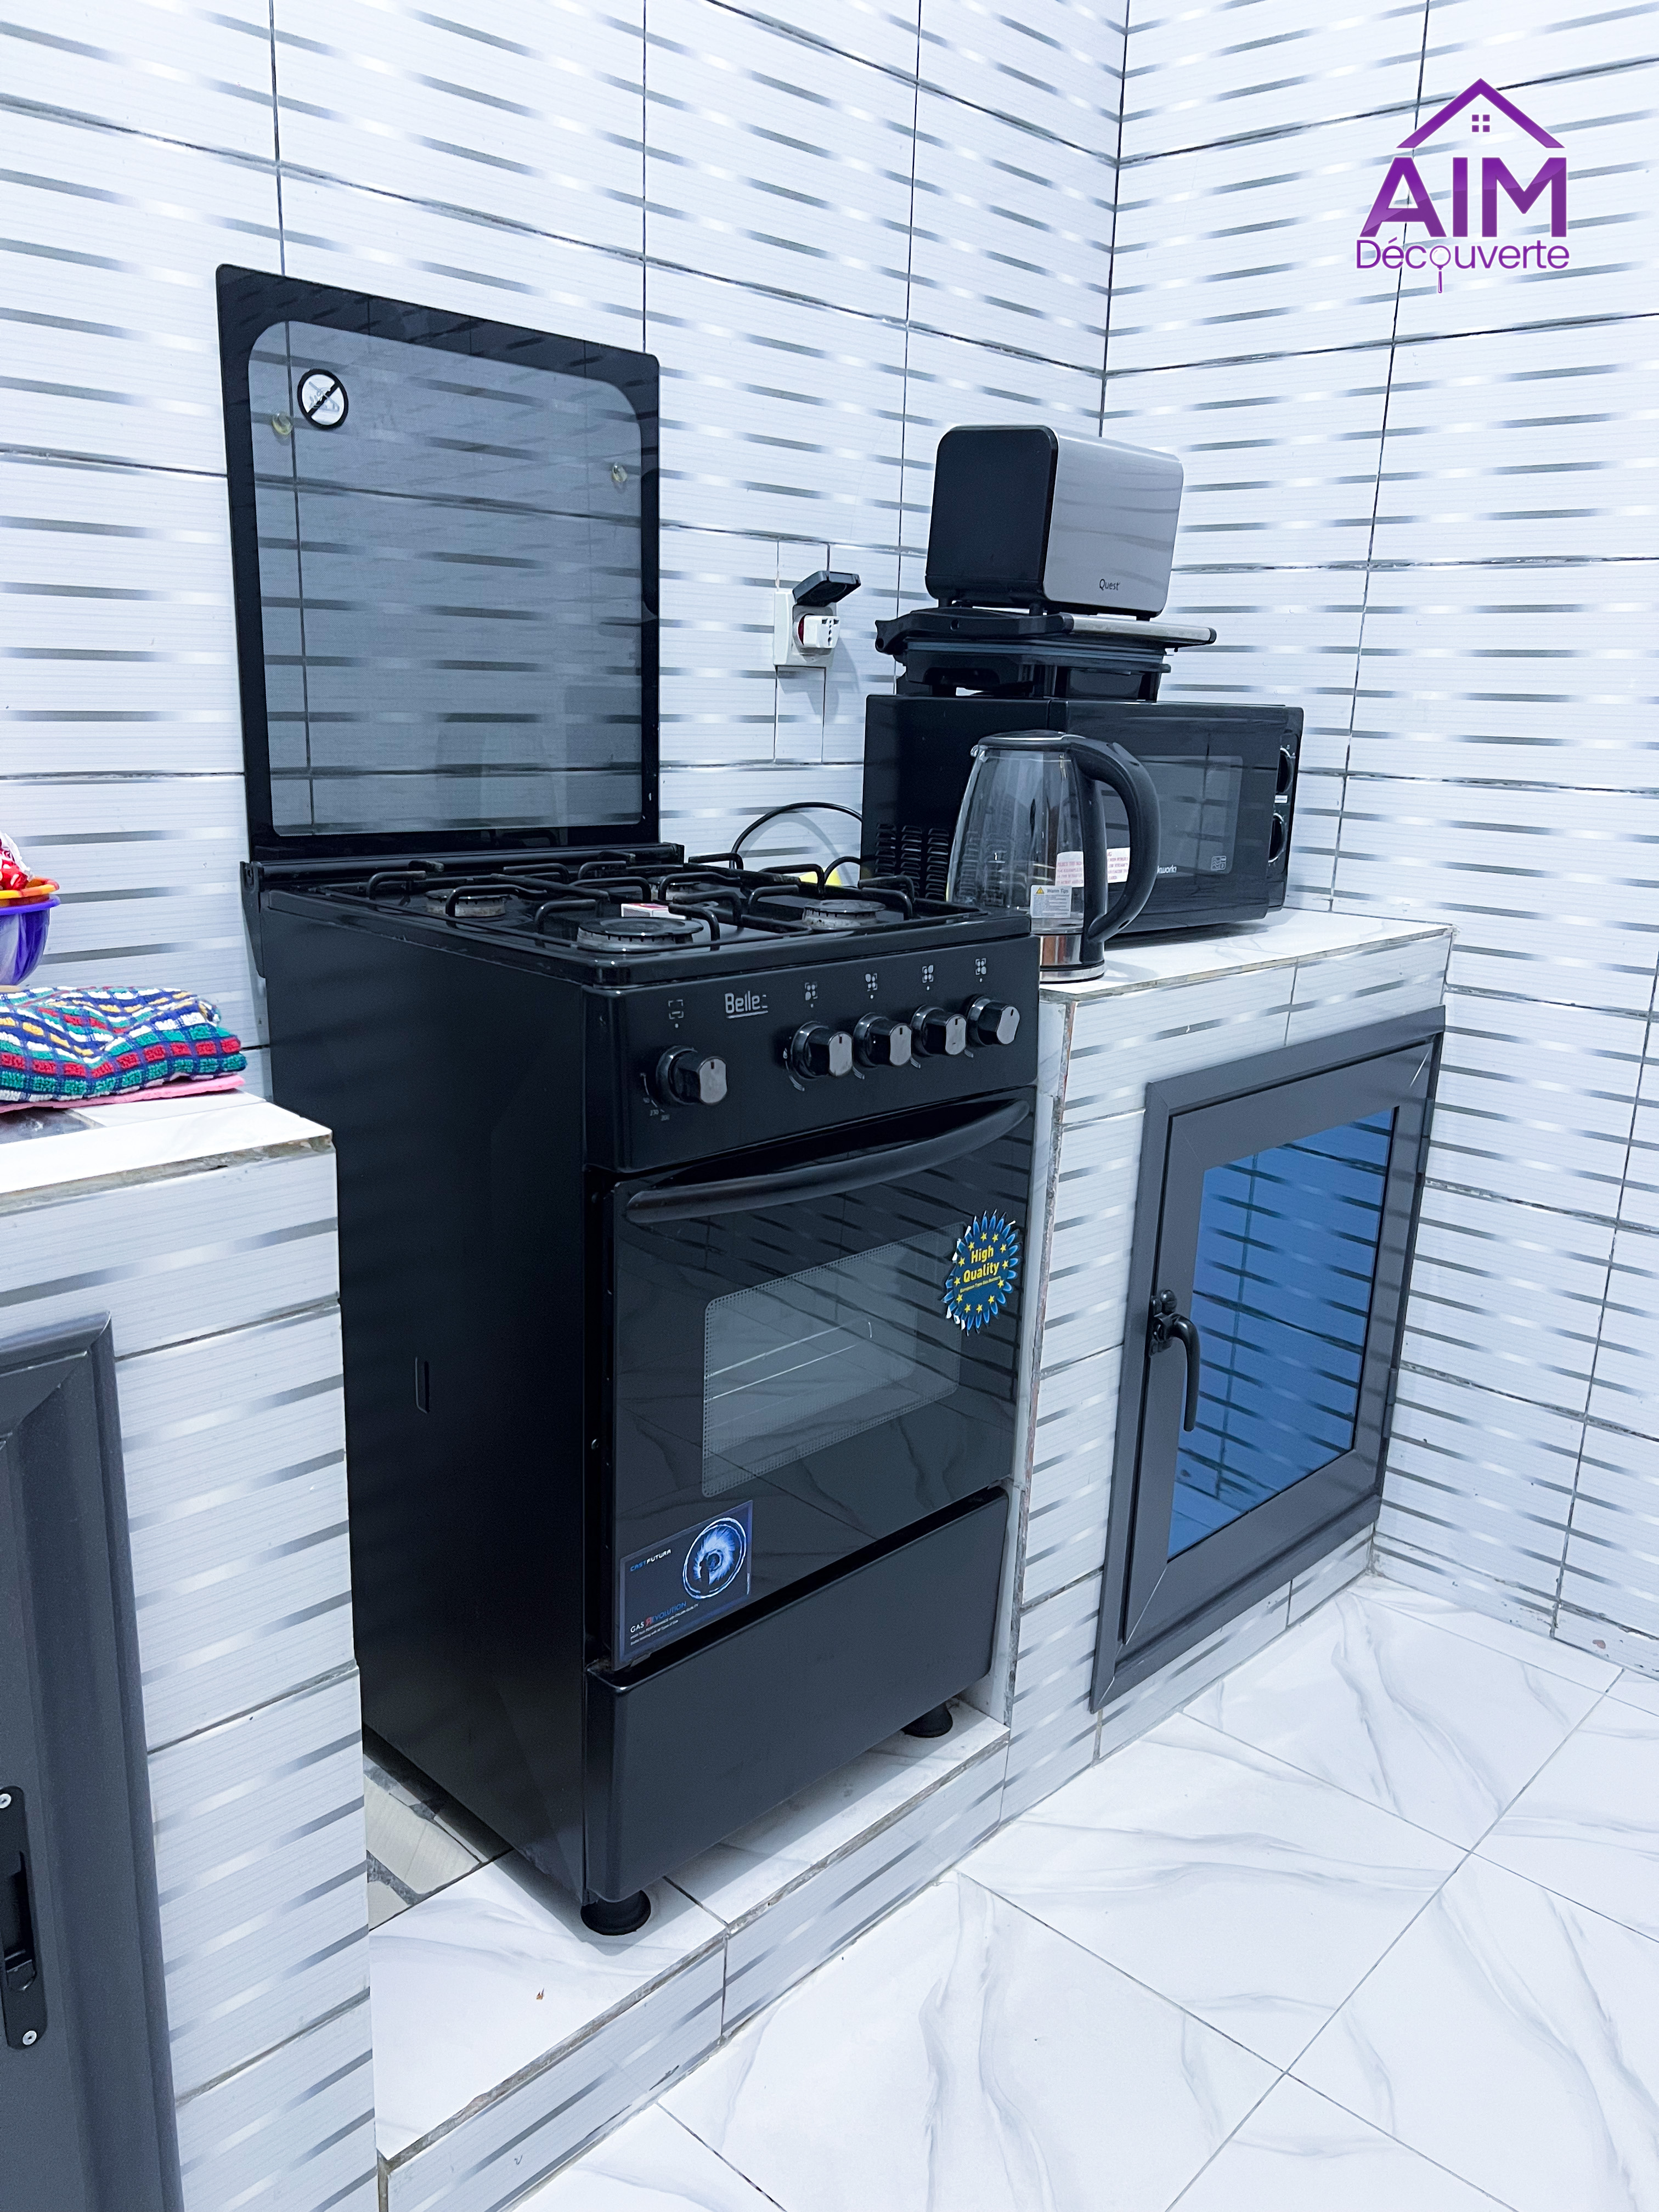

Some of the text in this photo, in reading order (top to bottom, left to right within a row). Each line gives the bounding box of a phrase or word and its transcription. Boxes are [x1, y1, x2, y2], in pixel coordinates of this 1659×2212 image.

[1099, 578, 1120, 591] Quest
[725, 990, 761, 1014] Belle
[970, 1245, 994, 1264] High
[963, 1262, 1000, 1283] Quality
[630, 1621, 645, 1633] GAS
